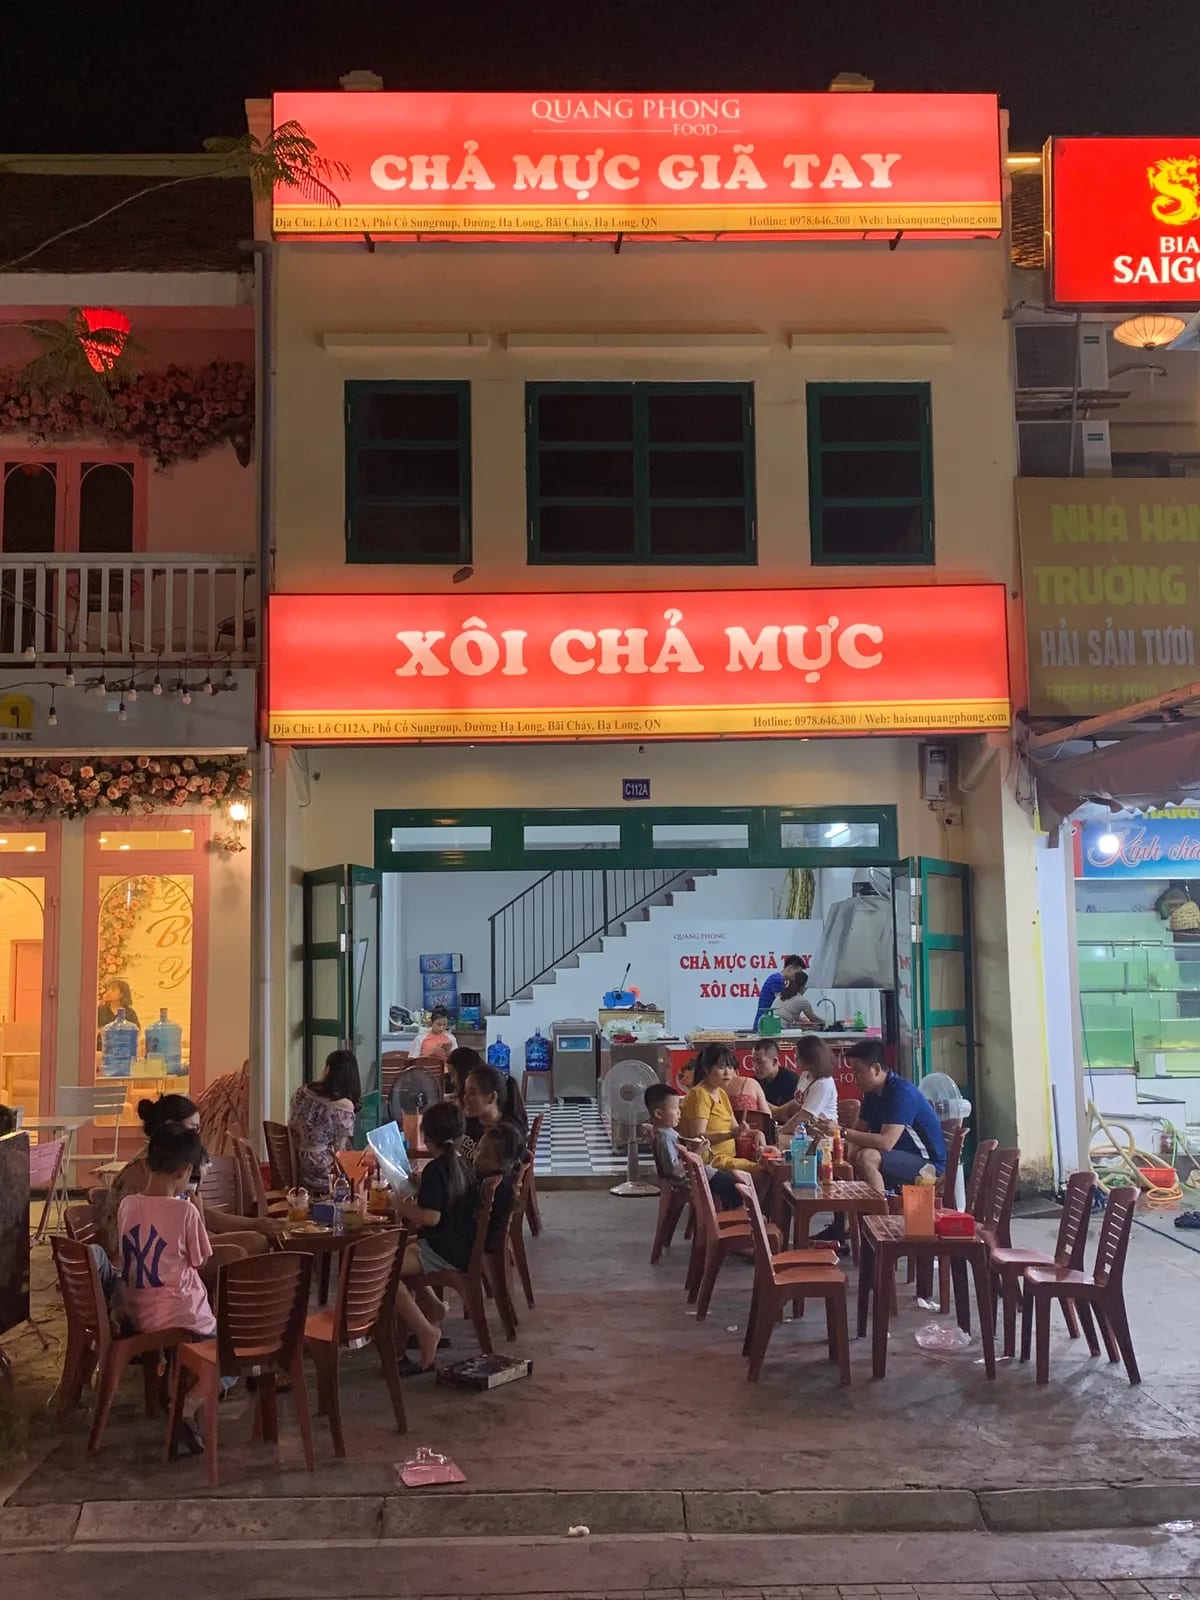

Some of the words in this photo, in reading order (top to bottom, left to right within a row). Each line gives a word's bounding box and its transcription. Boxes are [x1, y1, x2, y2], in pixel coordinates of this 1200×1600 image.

[531, 99, 633, 123] QUANG
[643, 99, 740, 119] PHONG
[673, 123, 718, 136] FOOD
[370, 140, 496, 191] CHẢ
[512, 148, 641, 200] MỰC
[658, 143, 768, 190] GIÃ
[783, 153, 902, 189] TAY
[335, 217, 370, 229] C112A,
[373, 214, 392, 227] Phố
[411, 217, 460, 230] Sungroup,
[499, 217, 512, 229] Hạ
[516, 217, 543, 229] Long,
[546, 217, 562, 227] Bãi
[595, 217, 608, 229] Hạ
[612, 217, 639, 229] Long,
[641, 216, 658, 228] QN
[749, 215, 787, 226] Hotline:
[790, 215, 850, 226] 0978.646.300
[859, 215, 884, 225] Web:
[887, 214, 997, 227] haisanquangphong.com
[1159, 236, 1200, 253] BIA
[1113, 255, 1200, 284] SAIG
[395, 616, 528, 677] XÔI
[550, 608, 704, 675] CHẢ
[724, 616, 883, 683] MỰC
[1040, 617, 1080, 667] HẢI
[1087, 617, 1136, 666] SẢN
[273, 723, 290, 736] Địa
[333, 723, 370, 735] C112A,
[373, 719, 391, 733] Phố
[394, 719, 408, 733] Cổ
[411, 722, 461, 735] Sungroup,
[464, 722, 497, 733] Đường
[500, 722, 514, 734] Hạ
[517, 721, 545, 733] Long,
[548, 721, 564, 731] Bãi
[598, 720, 611, 733] Hạ
[614, 719, 642, 731] Long,
[644, 718, 661, 730] QN
[754, 716, 792, 727] Hotline:
[795, 714, 857, 726] 0978.646.300
[865, 713, 890, 724] Web:
[893, 711, 1007, 725] haisanquangphong.com
[0, 732, 33, 741] RINK
[625, 783, 648, 796] C112A
[679, 950, 711, 970] CHẢ
[713, 952, 746, 973] MỰC
[750, 951, 778, 969] GIÃ
[700, 979, 727, 998] XÔI
[730, 977, 761, 998] CHẢ
[121, 1223, 168, 1289] NY
